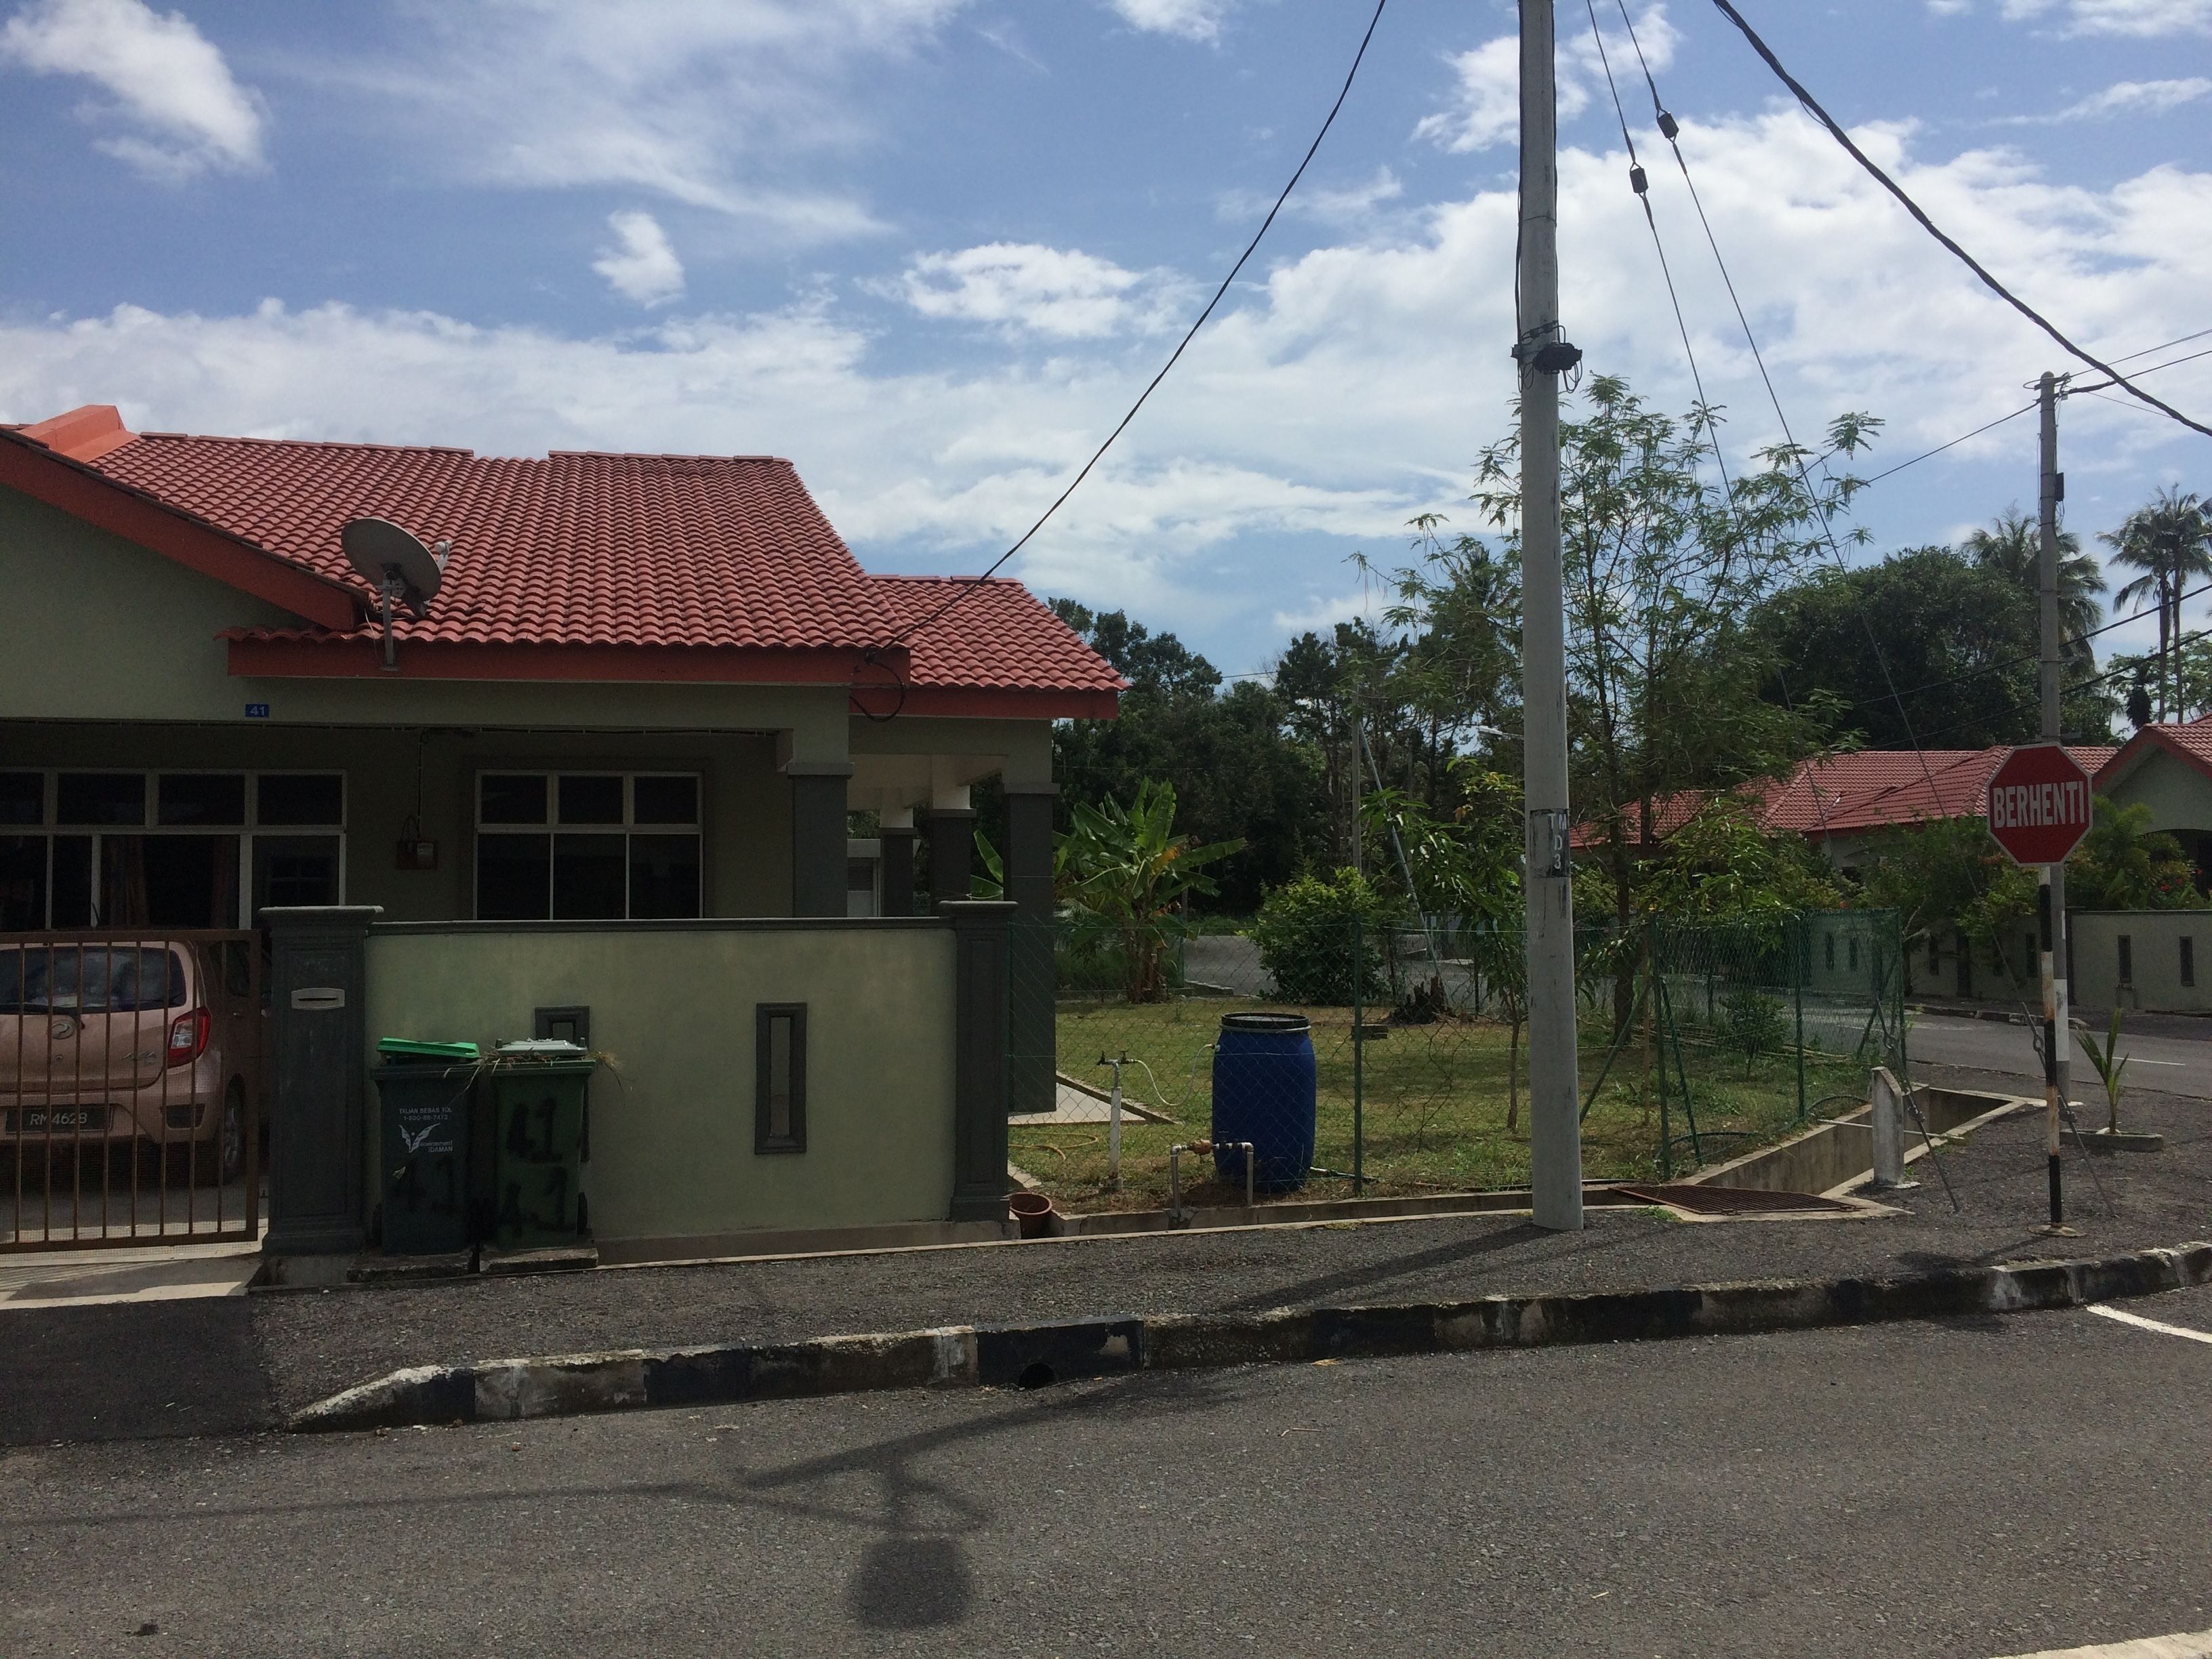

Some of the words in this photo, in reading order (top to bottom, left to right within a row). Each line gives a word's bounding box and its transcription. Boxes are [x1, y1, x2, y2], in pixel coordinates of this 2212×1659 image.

[250, 705, 265, 716] 41
[1993, 781, 2085, 828] BERHENTI
[1549, 813, 1567, 830] TM
[1554, 853, 1561, 869] 3
